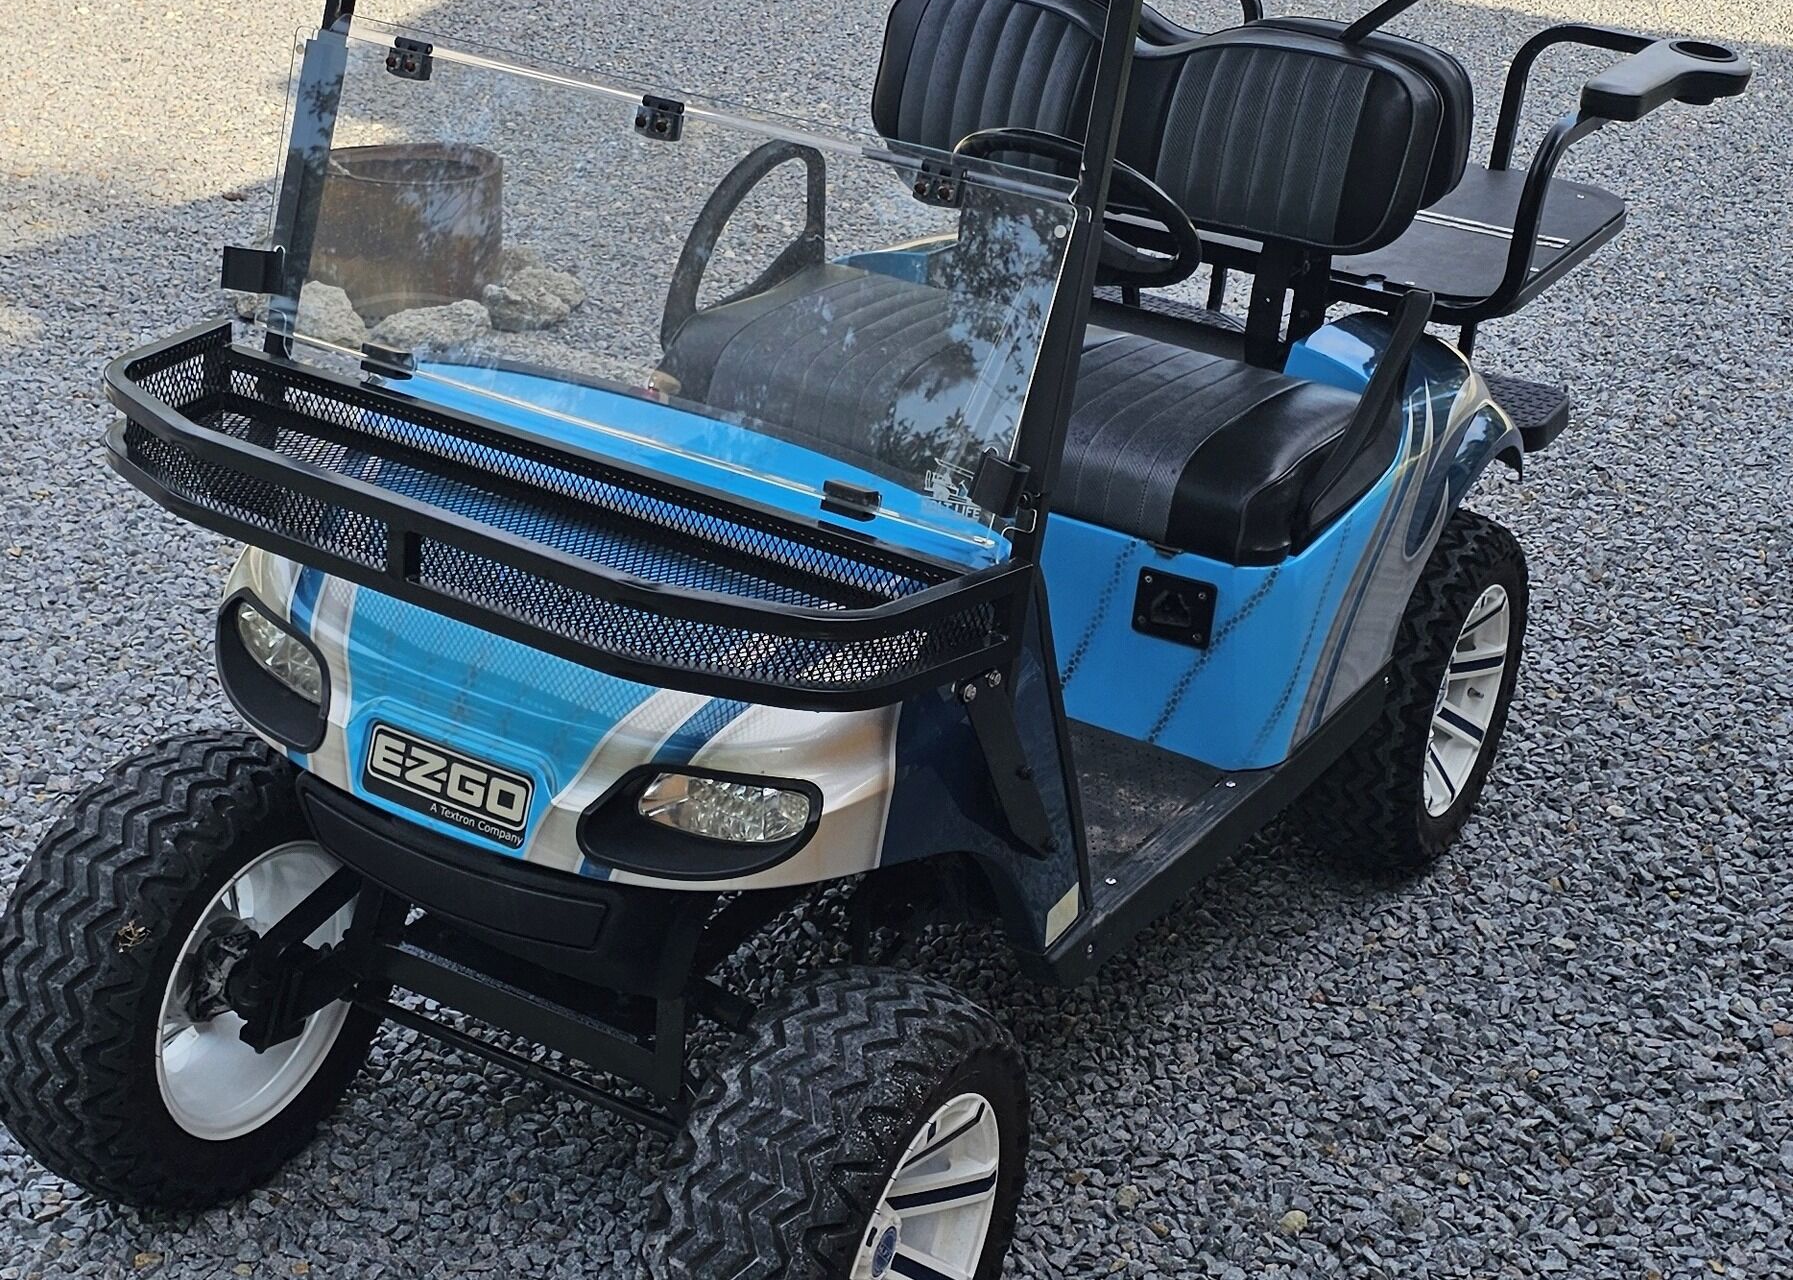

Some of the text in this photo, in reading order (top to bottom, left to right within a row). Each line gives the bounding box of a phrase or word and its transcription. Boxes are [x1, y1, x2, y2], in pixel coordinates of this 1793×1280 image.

[430, 803, 524, 847] A Textron Company
